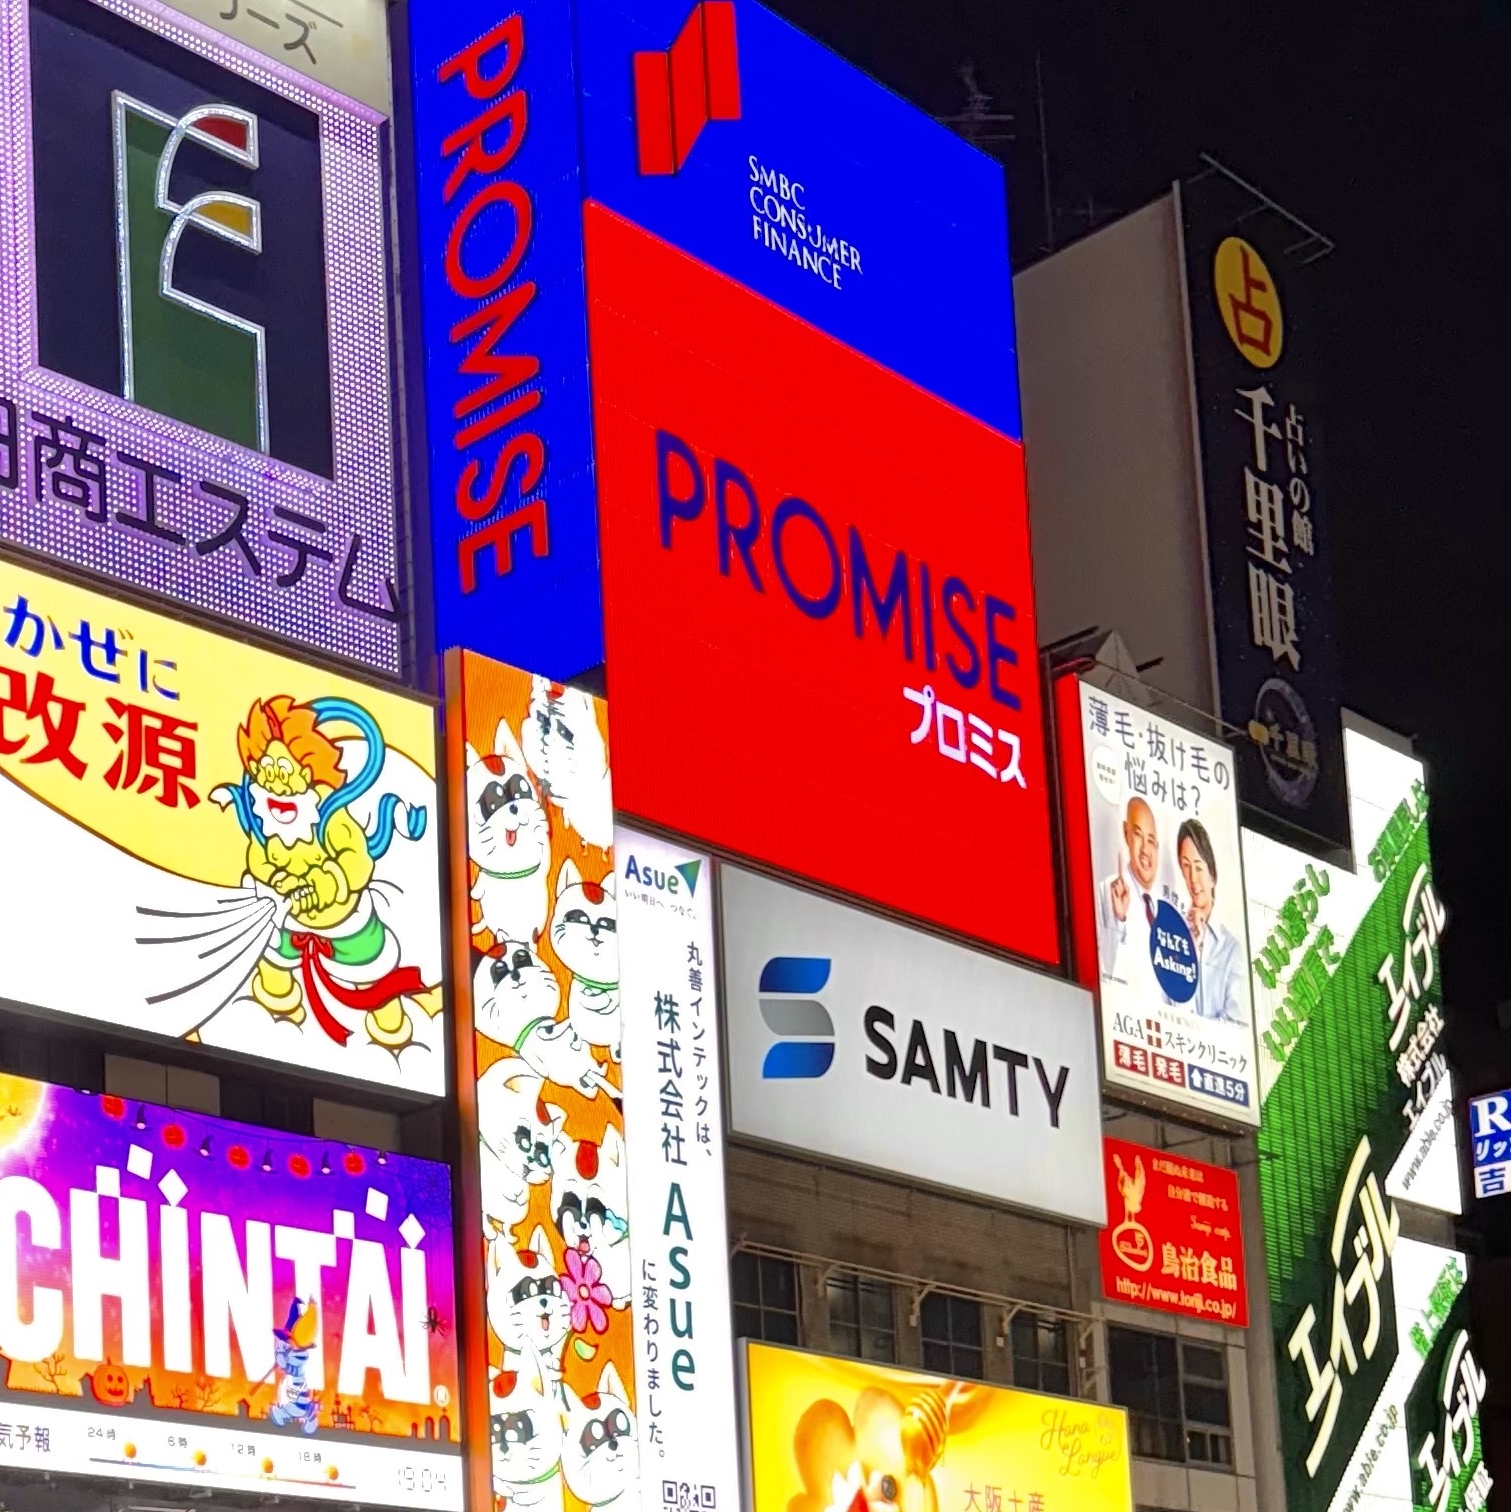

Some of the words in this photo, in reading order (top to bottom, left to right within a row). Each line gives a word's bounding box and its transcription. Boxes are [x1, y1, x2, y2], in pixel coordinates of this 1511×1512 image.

[748, 154, 806, 212] SMBC
[750, 185, 864, 276] CONSUMER
[437, 9, 550, 595] PROMISE
[752, 214, 843, 291] FINANCE
[1231, 244, 1273, 359] 占
[654, 426, 1024, 713] PROMISE
[1234, 385, 1303, 674] 千里眼
[3, 594, 181, 702] かぜに
[902, 684, 1028, 790] プロミス
[624, 854, 680, 896] Asue
[653, 989, 689, 1167] 株式会社
[863, 1004, 1071, 1130] SAMTY
[1112, 1012, 1145, 1041] AGA
[1164, 1030, 1249, 1074] スキンクリニック
[662, 1181, 696, 1393] Asue
[1287, 1134, 1400, 1480] エイブル
[641, 1258, 666, 1460] に変わりました。
